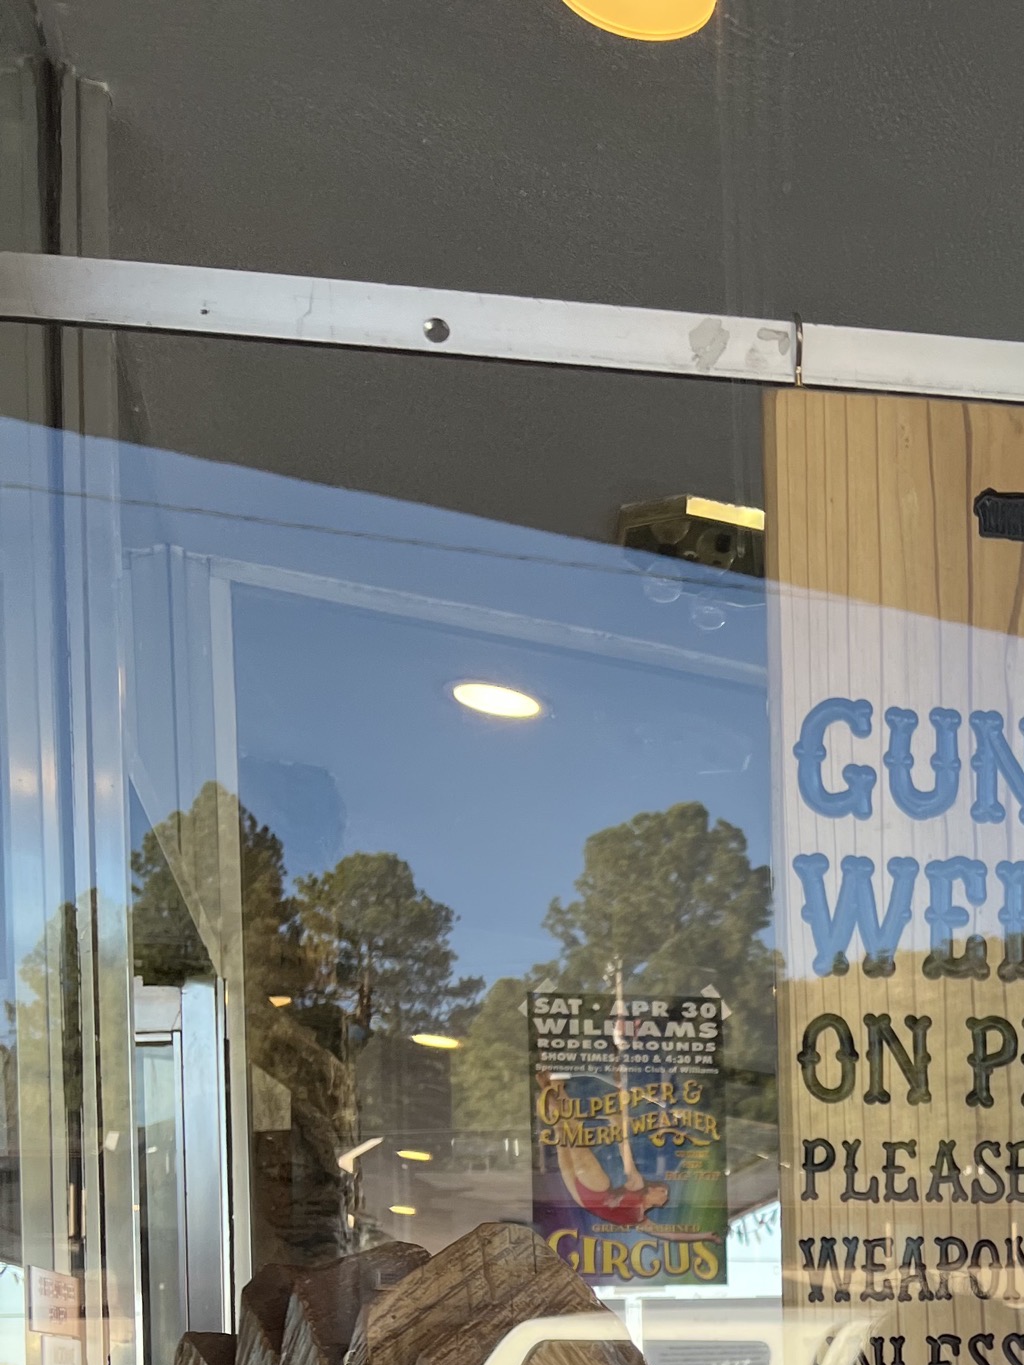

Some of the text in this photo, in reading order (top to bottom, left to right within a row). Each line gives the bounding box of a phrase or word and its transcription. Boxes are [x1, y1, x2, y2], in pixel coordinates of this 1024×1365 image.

[533, 997, 717, 1019] SAT APR 30
[533, 1017, 719, 1039] WILLIAMS
[537, 1038, 608, 1050] RODEO
[540, 1052, 577, 1062] SHOW
[622, 1053, 649, 1064] 2:00
[652, 1054, 661, 1063] &
[665, 1055, 691, 1065] 4:30
[695, 1055, 713, 1065] PM
[797, 1013, 932, 1106] ON
[683, 1079, 704, 1105] &
